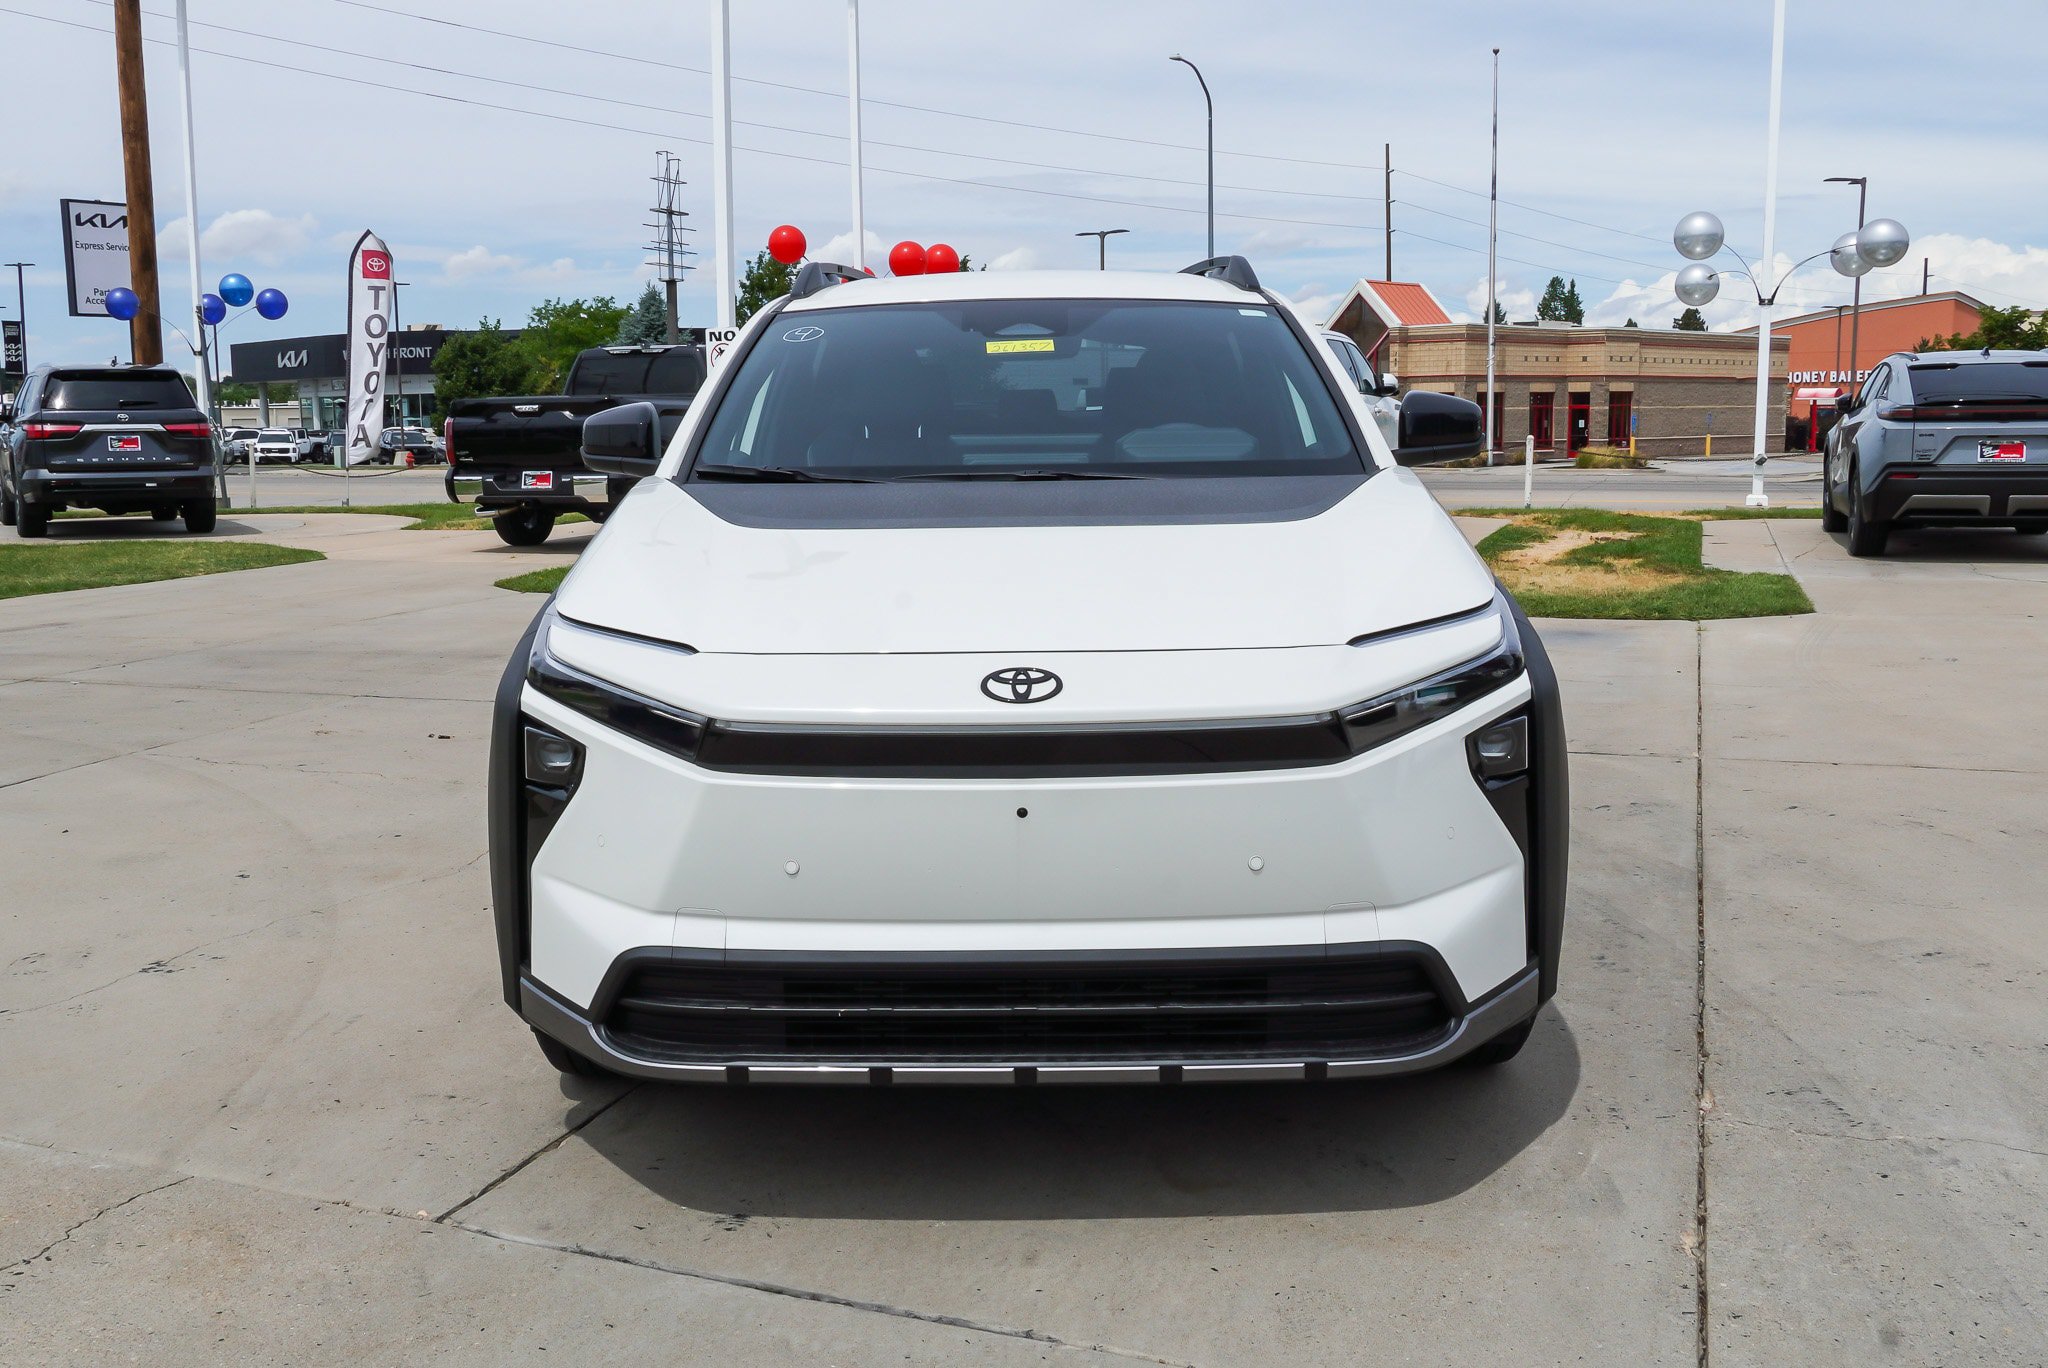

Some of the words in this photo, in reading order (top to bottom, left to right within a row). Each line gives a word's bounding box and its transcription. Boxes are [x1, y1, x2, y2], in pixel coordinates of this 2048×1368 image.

[75, 212, 128, 229] KIA
[75, 241, 104, 251] Express
[106, 243, 129, 251] Servic
[85, 297, 105, 305] Acce
[709, 330, 736, 341] NO
[277, 350, 308, 368] KIA
